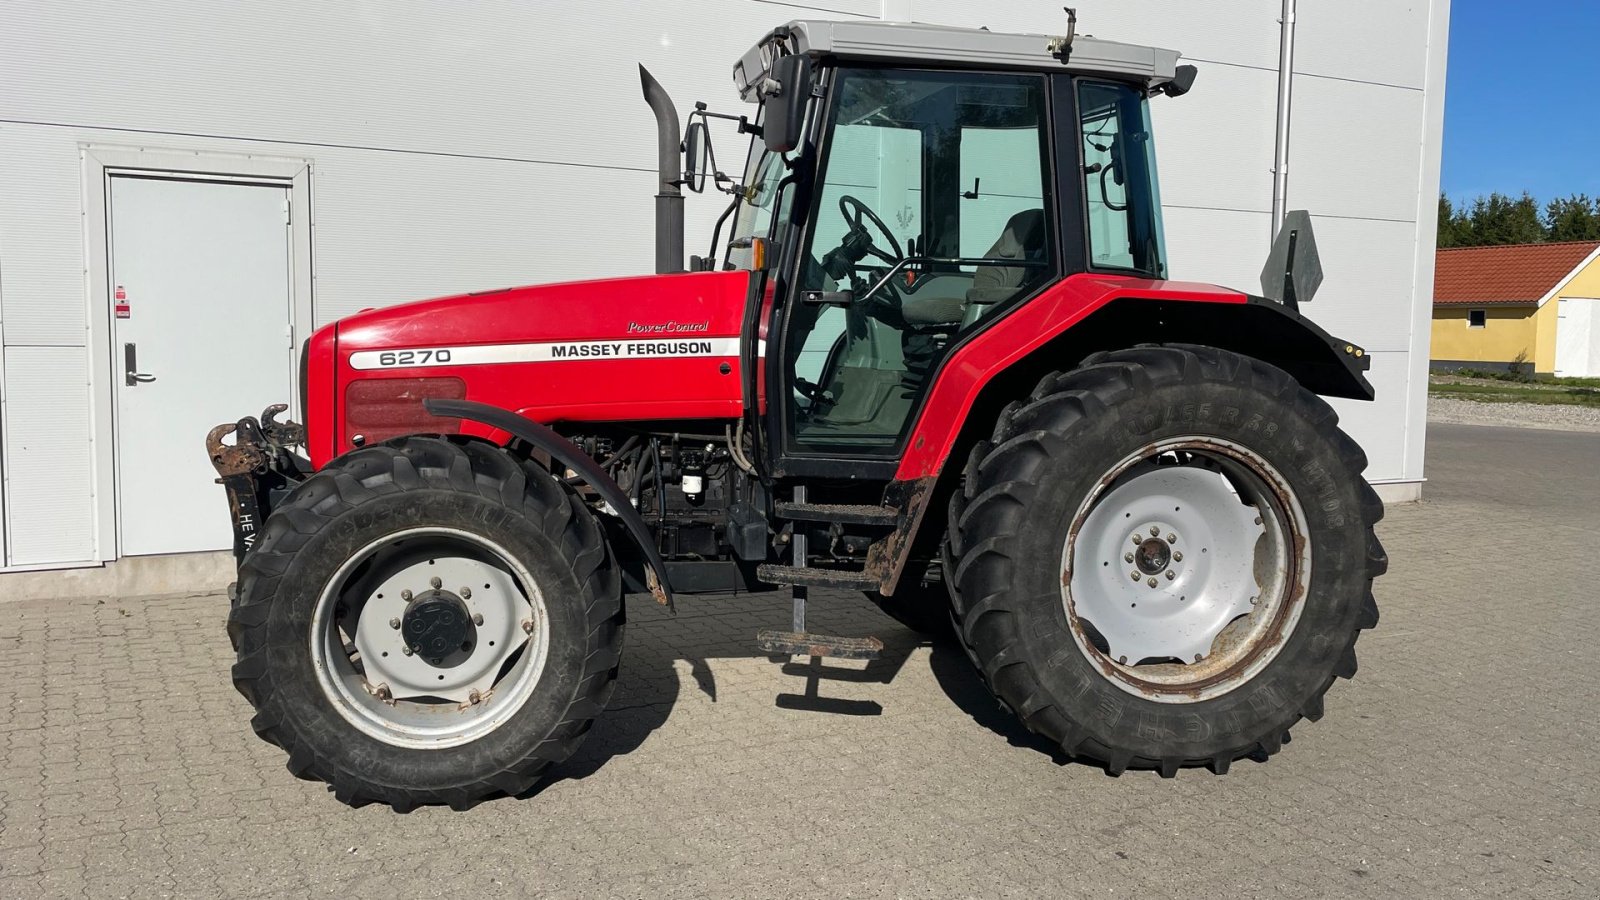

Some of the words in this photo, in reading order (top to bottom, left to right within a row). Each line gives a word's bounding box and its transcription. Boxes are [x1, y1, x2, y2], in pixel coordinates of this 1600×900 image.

[379, 350, 451, 366] 6270
[551, 344, 621, 358] MASSEY
[627, 342, 712, 355] FERGUSON
